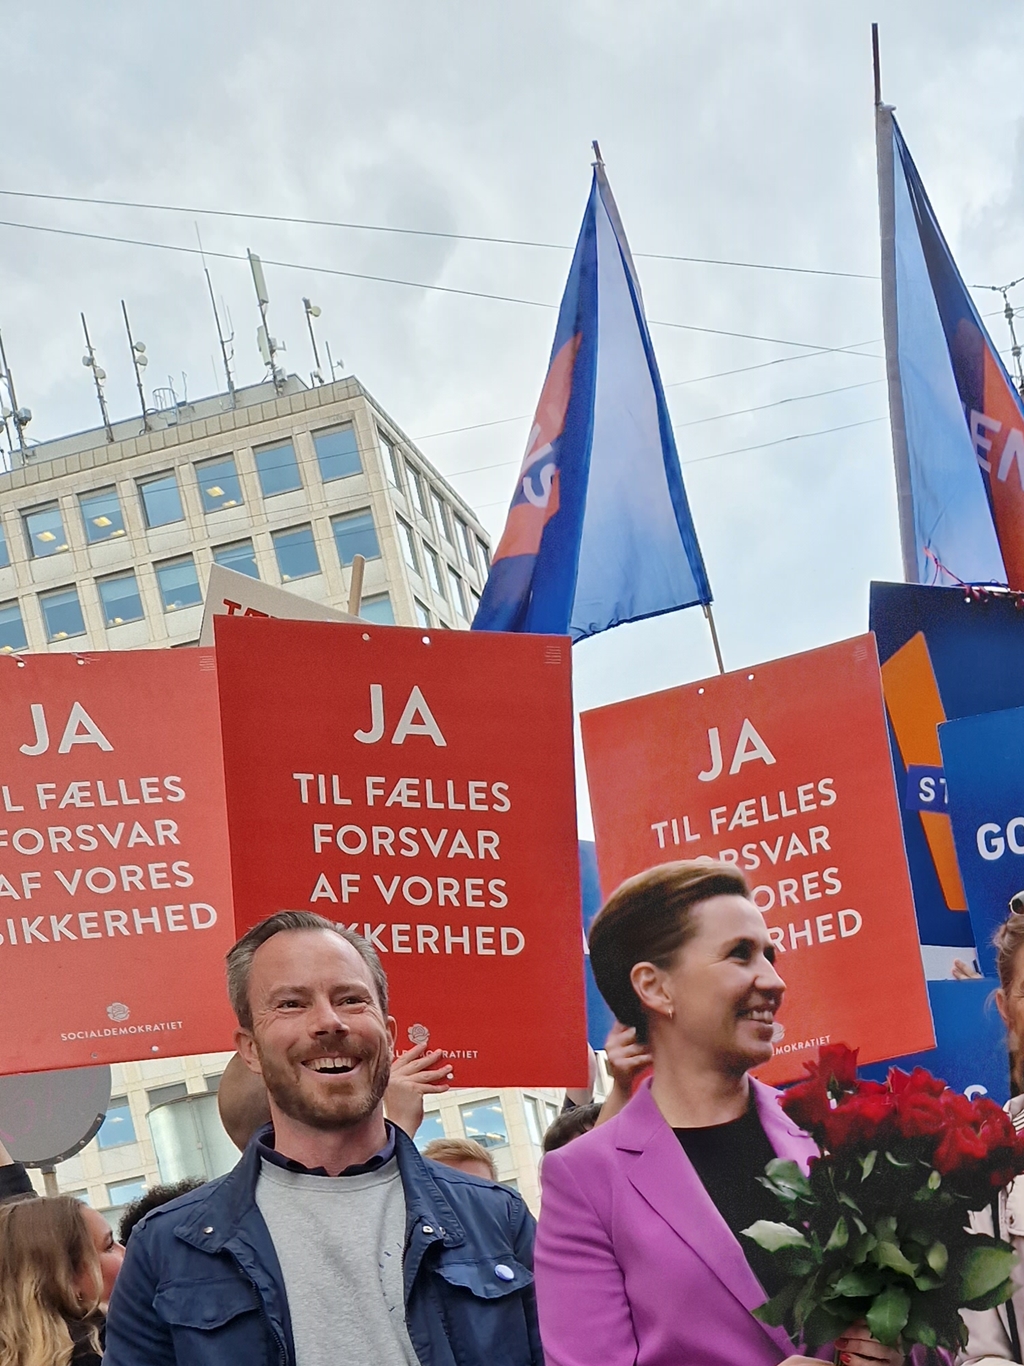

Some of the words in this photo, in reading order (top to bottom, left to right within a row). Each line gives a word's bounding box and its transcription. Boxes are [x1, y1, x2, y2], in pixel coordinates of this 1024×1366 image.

[19, 701, 114, 756] JA
[353, 683, 448, 747] JA
[697, 718, 777, 782] JA
[36, 775, 186, 810] FÆLLES
[292, 772, 352, 805] TIL
[365, 776, 511, 813] FÆLLES
[651, 815, 700, 849] TIL
[710, 777, 837, 835] FÆLLES
[313, 823, 500, 860] FORSVAR
[0, 871, 41, 900] AF
[54, 860, 194, 896] VORES
[309, 872, 361, 904] AF
[372, 874, 509, 909] VORES
[0, 902, 218, 946] IKKERHED
[61, 1020, 183, 1041] SOCIALDEMOKRATIET
